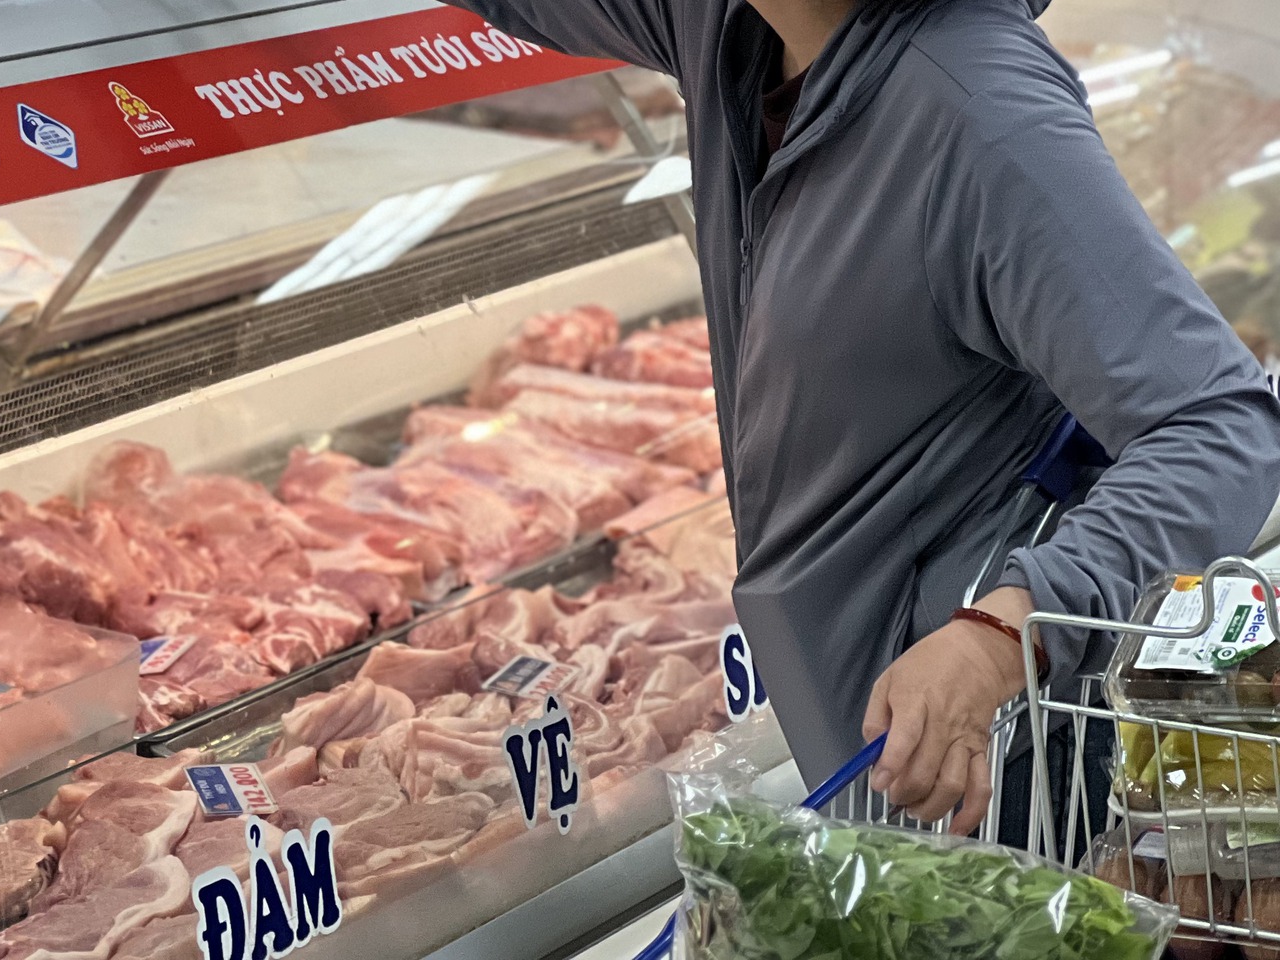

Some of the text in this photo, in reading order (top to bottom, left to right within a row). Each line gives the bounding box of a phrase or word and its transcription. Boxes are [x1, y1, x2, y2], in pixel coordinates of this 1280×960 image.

[134, 119, 167, 132] VISSAN
[194, 67, 305, 119] THỰC
[293, 47, 404, 100] PHẨM
[391, 33, 482, 79] TƯƠI
[505, 694, 580, 829] VỆ
[196, 822, 342, 960] ĐẢM
